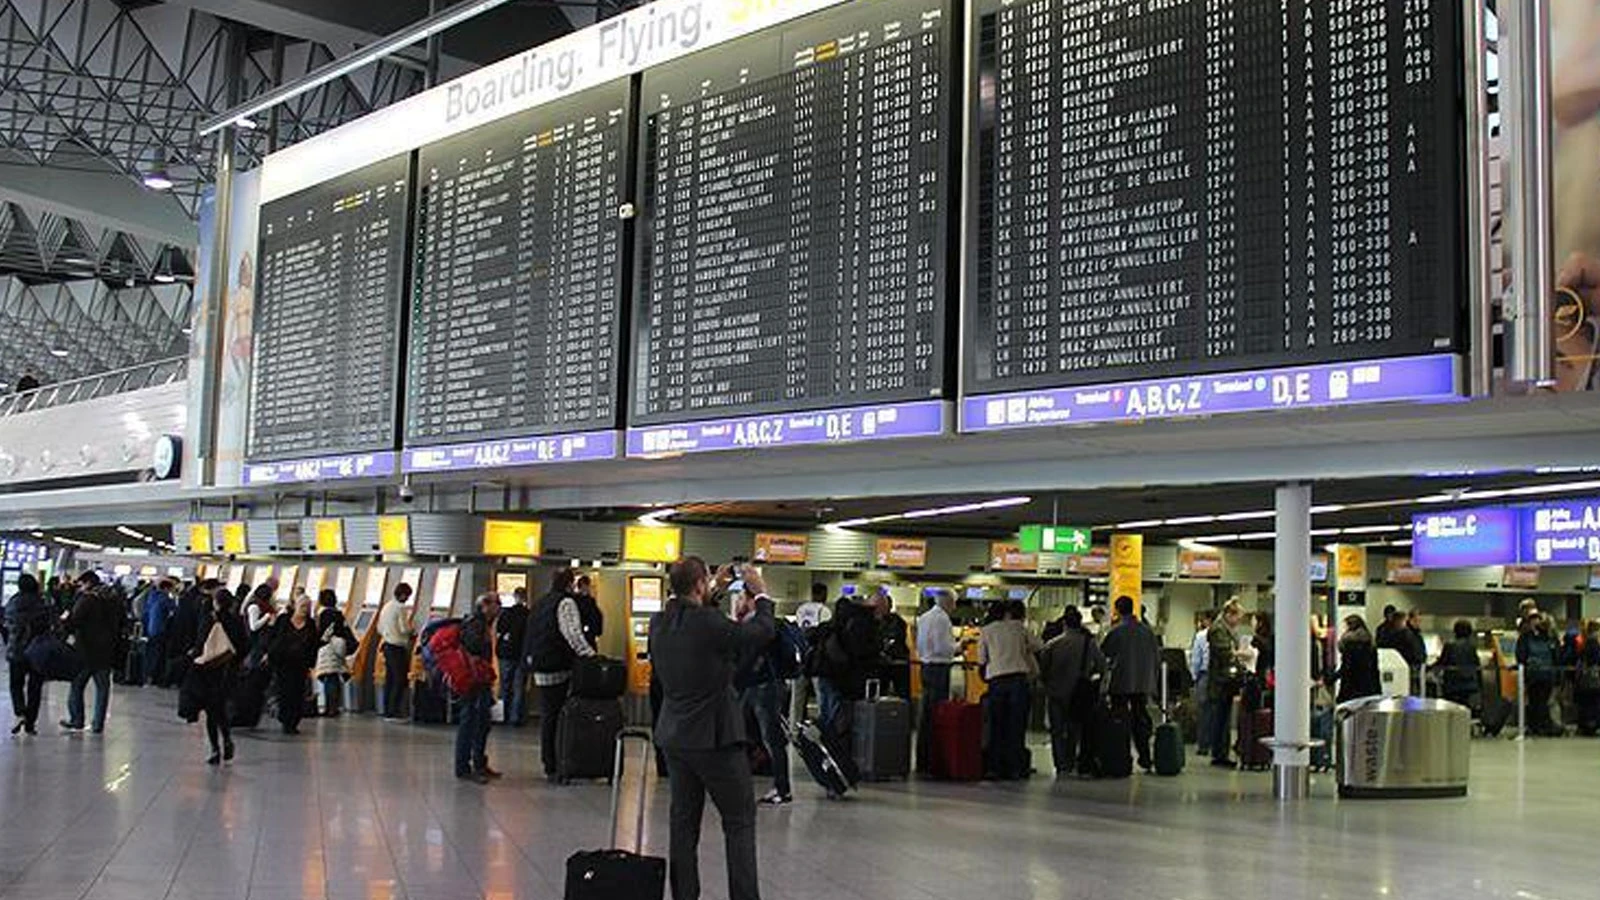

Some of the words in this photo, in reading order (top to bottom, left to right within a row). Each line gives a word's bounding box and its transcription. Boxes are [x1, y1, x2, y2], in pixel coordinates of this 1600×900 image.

[1062, 29, 1100, 49] MADRID
[1148, 0, 1189, 11] GAU
[446, 50, 583, 122] Boarding.
[599, 3, 712, 68] Flying.
[1001, 82, 1012, 94] LH
[1305, 8, 1312, 19] A
[1329, 0, 1384, 14] 260-
[1001, 111, 1012, 123] LH
[1063, 87, 1114, 108] MUENCHEN
[1305, 42, 1312, 52] A
[1330, 25, 1386, 47] 260-338
[1404, 15, 1429, 30] A13
[1062, 80, 1080, 93] SAN
[1088, 63, 1148, 87] FRANCISCO
[1305, 24, 1312, 37] B
[1305, 75, 1312, 86] A
[1330, 60, 1386, 82] 260-338
[1405, 50, 1430, 65] A28
[1000, 155, 1011, 166] LH
[1305, 92, 1312, 103] A
[1331, 77, 1386, 98] 260-338
[1405, 68, 1430, 83] B31
[1001, 126, 1012, 137] LH
[1305, 58, 1312, 69] A
[1330, 42, 1386, 64] 260-338
[1405, 35, 1421, 48] A5
[999, 170, 1011, 181] LH
[1062, 138, 1161, 169] OSLO-ANNULLIERT
[1305, 109, 1313, 119] A
[1331, 94, 1387, 115] 260-338
[999, 184, 1011, 196] LH
[1306, 126, 1314, 137] A
[1331, 112, 1388, 133] 260-338
[999, 199, 1010, 211] LH
[1061, 183, 1093, 198] PARIS
[1100, 180, 1119, 192] CH.
[1128, 174, 1140, 187] DE
[1148, 165, 1189, 183] GAULLE
[1306, 143, 1313, 154] A
[1331, 129, 1388, 150] 260-338
[1407, 125, 1415, 136] A
[998, 244, 1010, 255] LH
[1307, 194, 1314, 205] A
[1332, 182, 1388, 202] 260-338
[999, 215, 1010, 226] LH
[1062, 195, 1113, 214] SALZBURG
[1306, 160, 1314, 171] A
[1331, 147, 1388, 167] 260-338
[1407, 143, 1415, 153] A
[999, 229, 1010, 241] SK
[1061, 199, 1183, 229] KOPENHAGEN-KASTRUP
[1307, 177, 1314, 188] A
[1331, 164, 1388, 184] 260-338
[1407, 160, 1415, 171] A
[998, 259, 1010, 270] LH
[1307, 211, 1314, 222] A
[1332, 200, 1389, 219] 260-338
[998, 274, 1010, 285] LH
[1060, 247, 1182, 276] LEIPZIG-ANNULLIERT
[1307, 228, 1314, 240] A
[1332, 217, 1389, 237] 260-338
[998, 289, 1009, 300] LH
[1062, 273, 1119, 291] INNSBRUCK
[1307, 245, 1314, 257] A
[1332, 235, 1389, 254] 260-338
[1408, 232, 1416, 243] A
[997, 304, 1009, 315] LH
[1060, 280, 1182, 307] ZUERICH-ANNULLIERT
[1333, 253, 1390, 272] 260-338
[997, 319, 1009, 329] LH
[1307, 280, 1314, 292] A
[1333, 270, 1390, 289] 260-338
[997, 334, 1009, 344] LH
[1060, 314, 1175, 338] BREMEN-ANNULLIERT
[1307, 298, 1314, 309] A
[1333, 289, 1391, 307] 260-338
[997, 350, 1009, 359] LH
[1060, 332, 1161, 353] GRAZ-ANNULLIERT
[1307, 316, 1314, 327] A
[1333, 307, 1390, 325] 260-338
[997, 365, 1009, 374] LH
[1307, 333, 1314, 344] A
[1333, 325, 1391, 343] 260-338
[1126, 382, 1202, 415] A,B,C,Z
